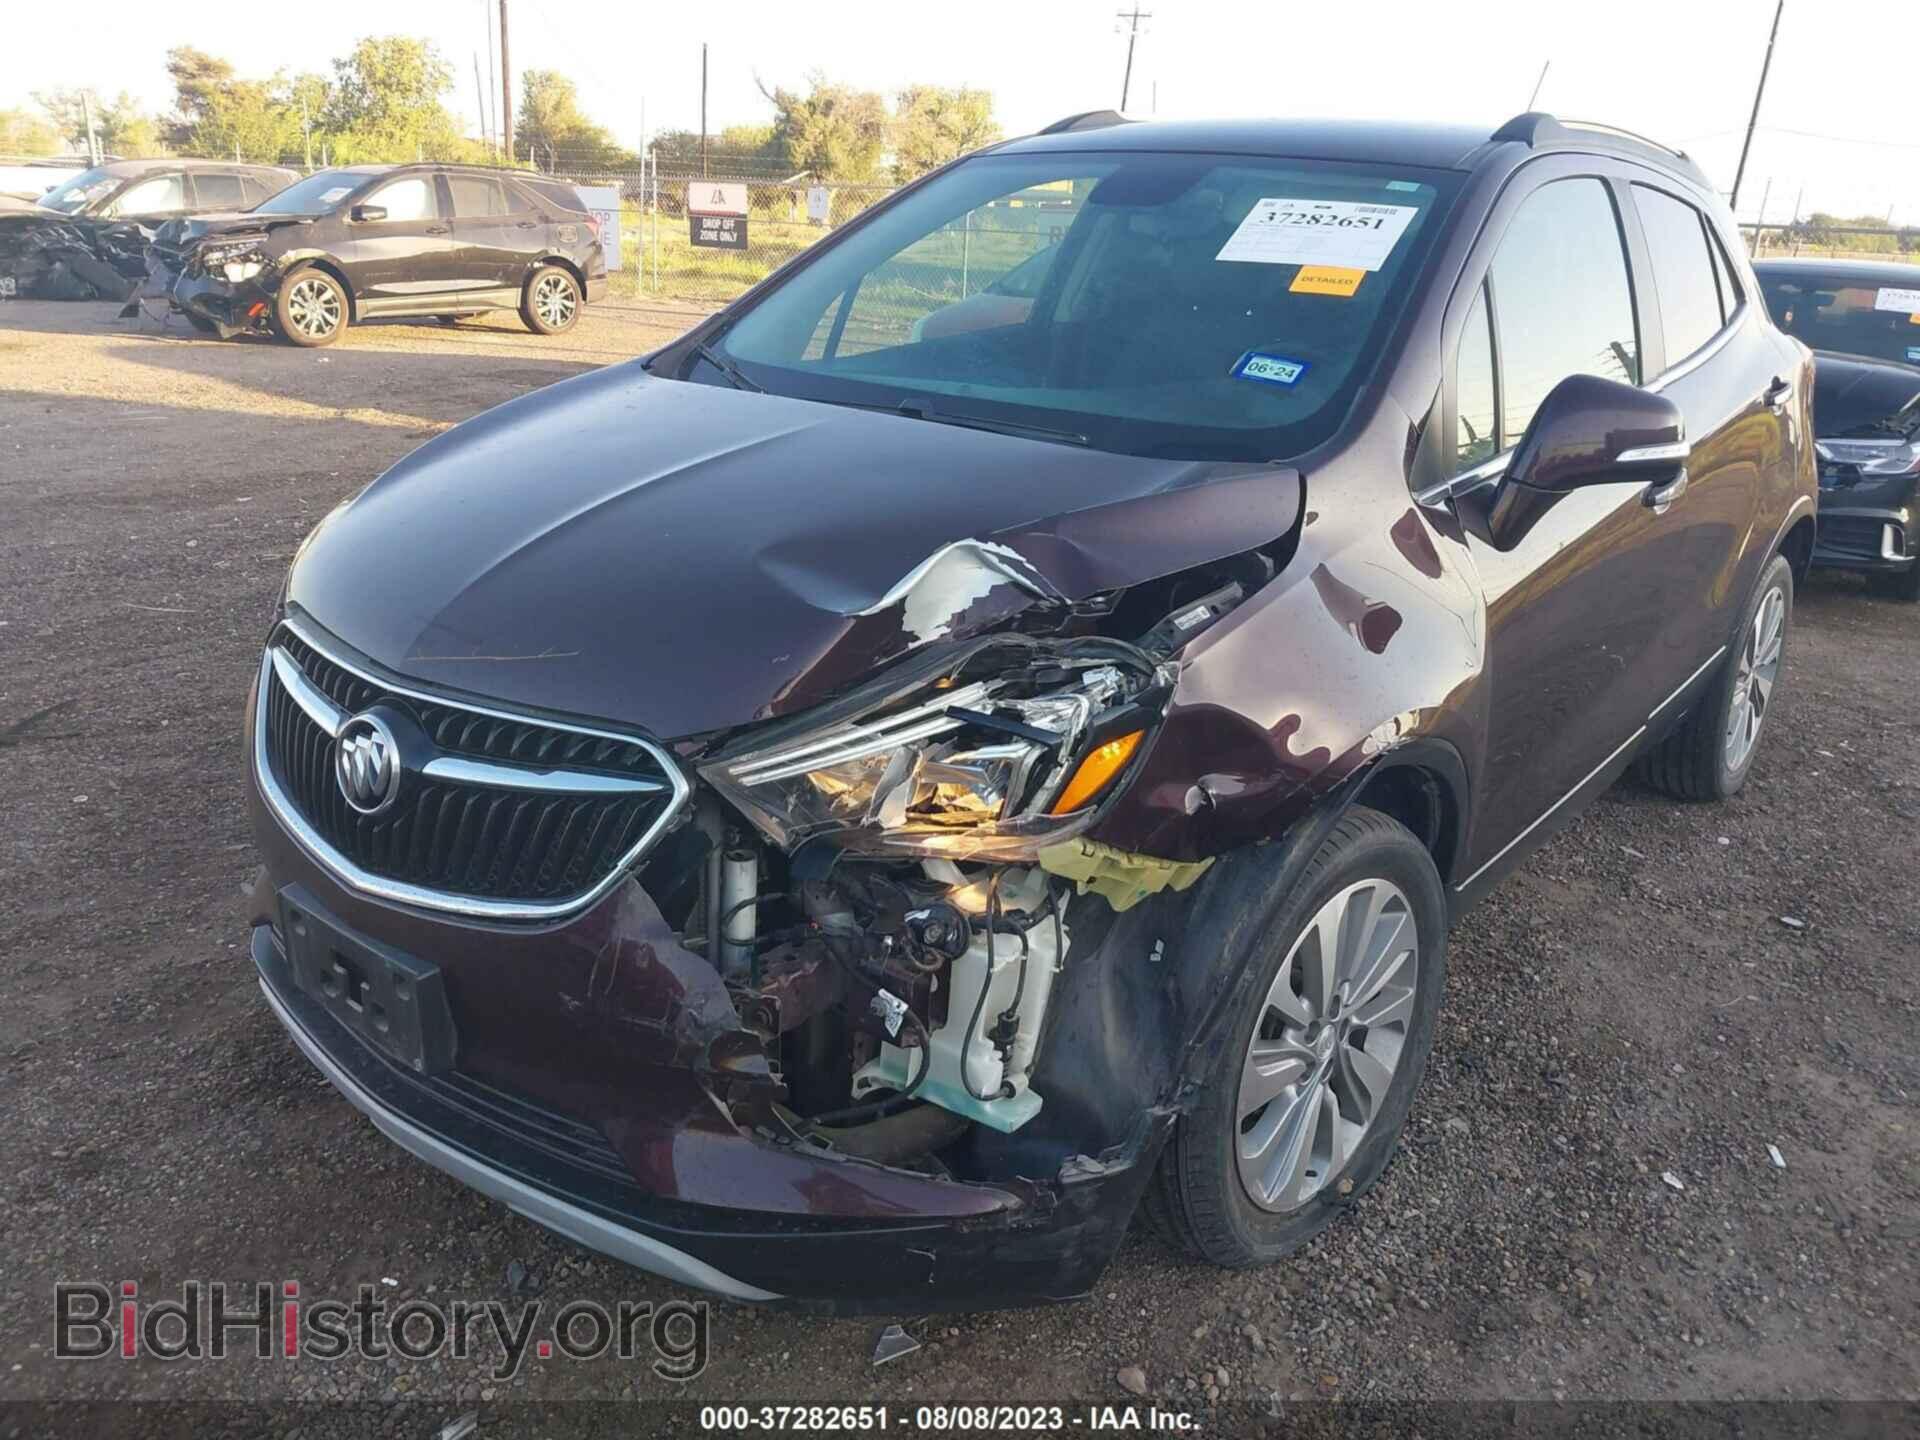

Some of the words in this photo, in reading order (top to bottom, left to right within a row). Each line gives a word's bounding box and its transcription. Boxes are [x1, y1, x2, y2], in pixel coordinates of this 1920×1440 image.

[702, 217, 721, 230] DROP
[1259, 210, 1384, 230] 37282651
[700, 230, 718, 241] ZONE
[719, 231, 738, 243] ONLY
[1302, 275, 1354, 285] DETAILED
